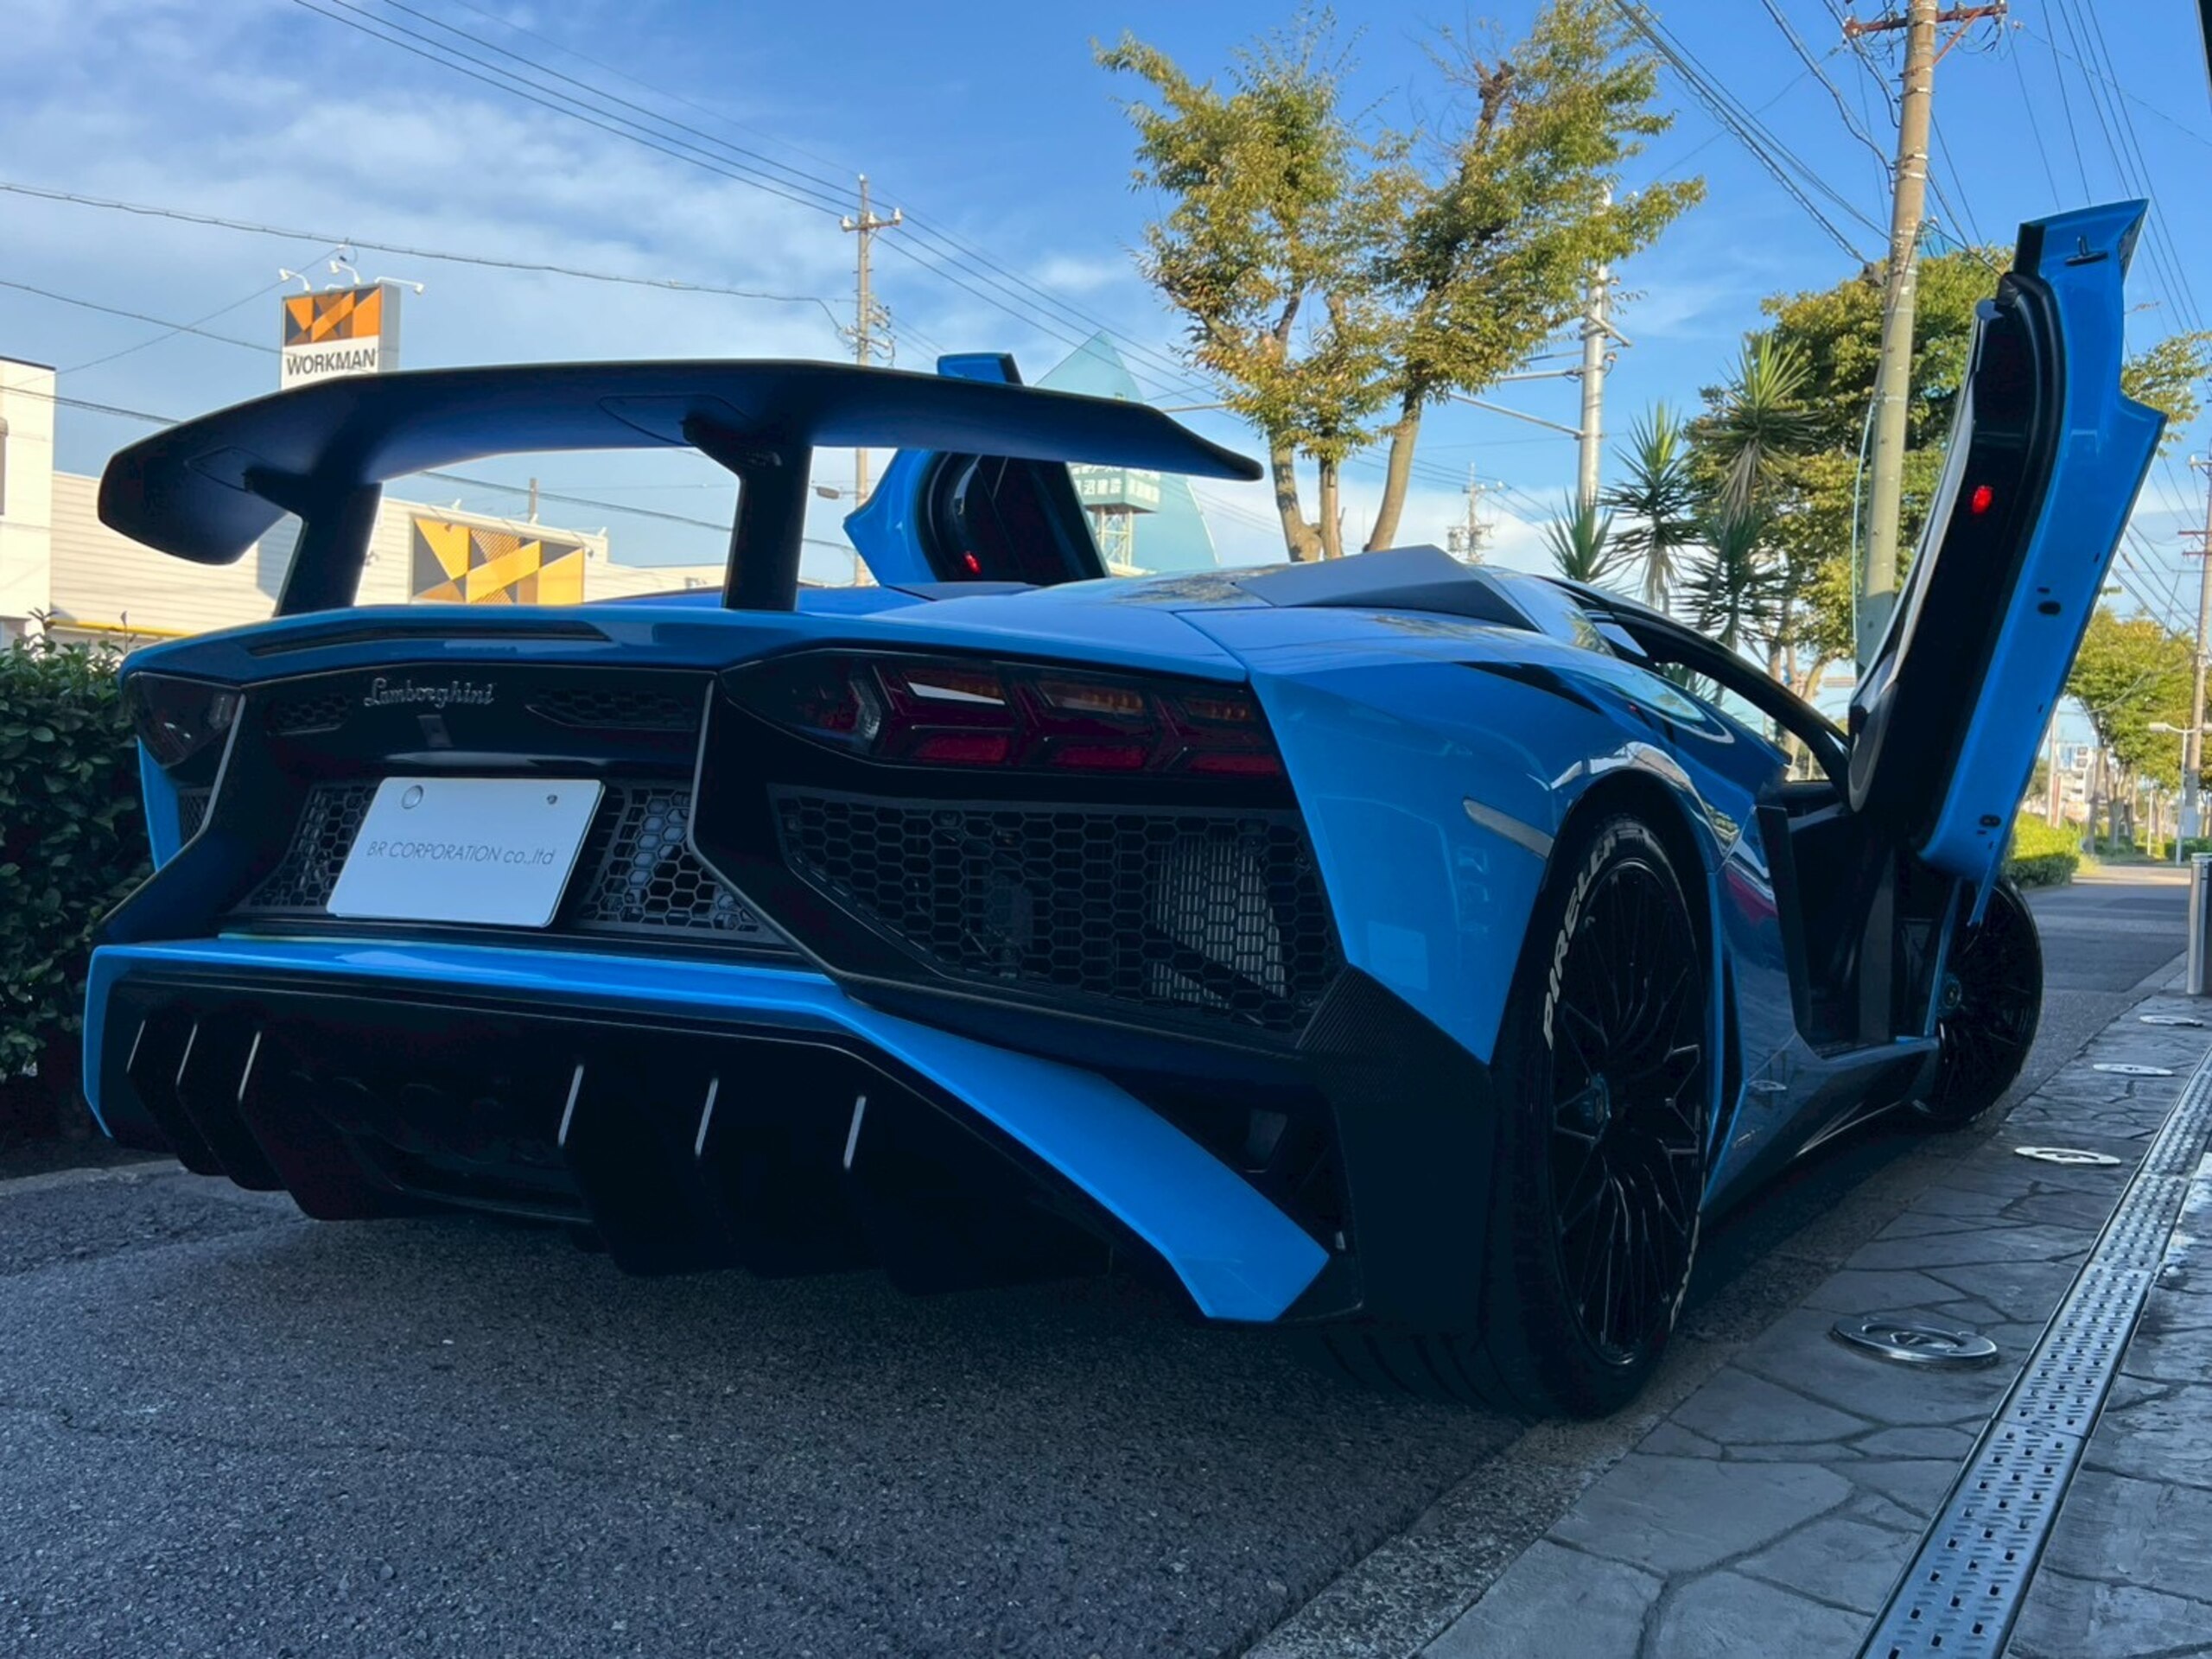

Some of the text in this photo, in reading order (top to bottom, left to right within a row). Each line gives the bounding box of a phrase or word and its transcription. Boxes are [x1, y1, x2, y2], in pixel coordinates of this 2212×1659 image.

[286, 347, 376, 376] WORKMAN
[363, 677, 495, 709] Lamborghini
[366, 841, 388, 857] BR
[389, 842, 502, 861] CORPORATION
